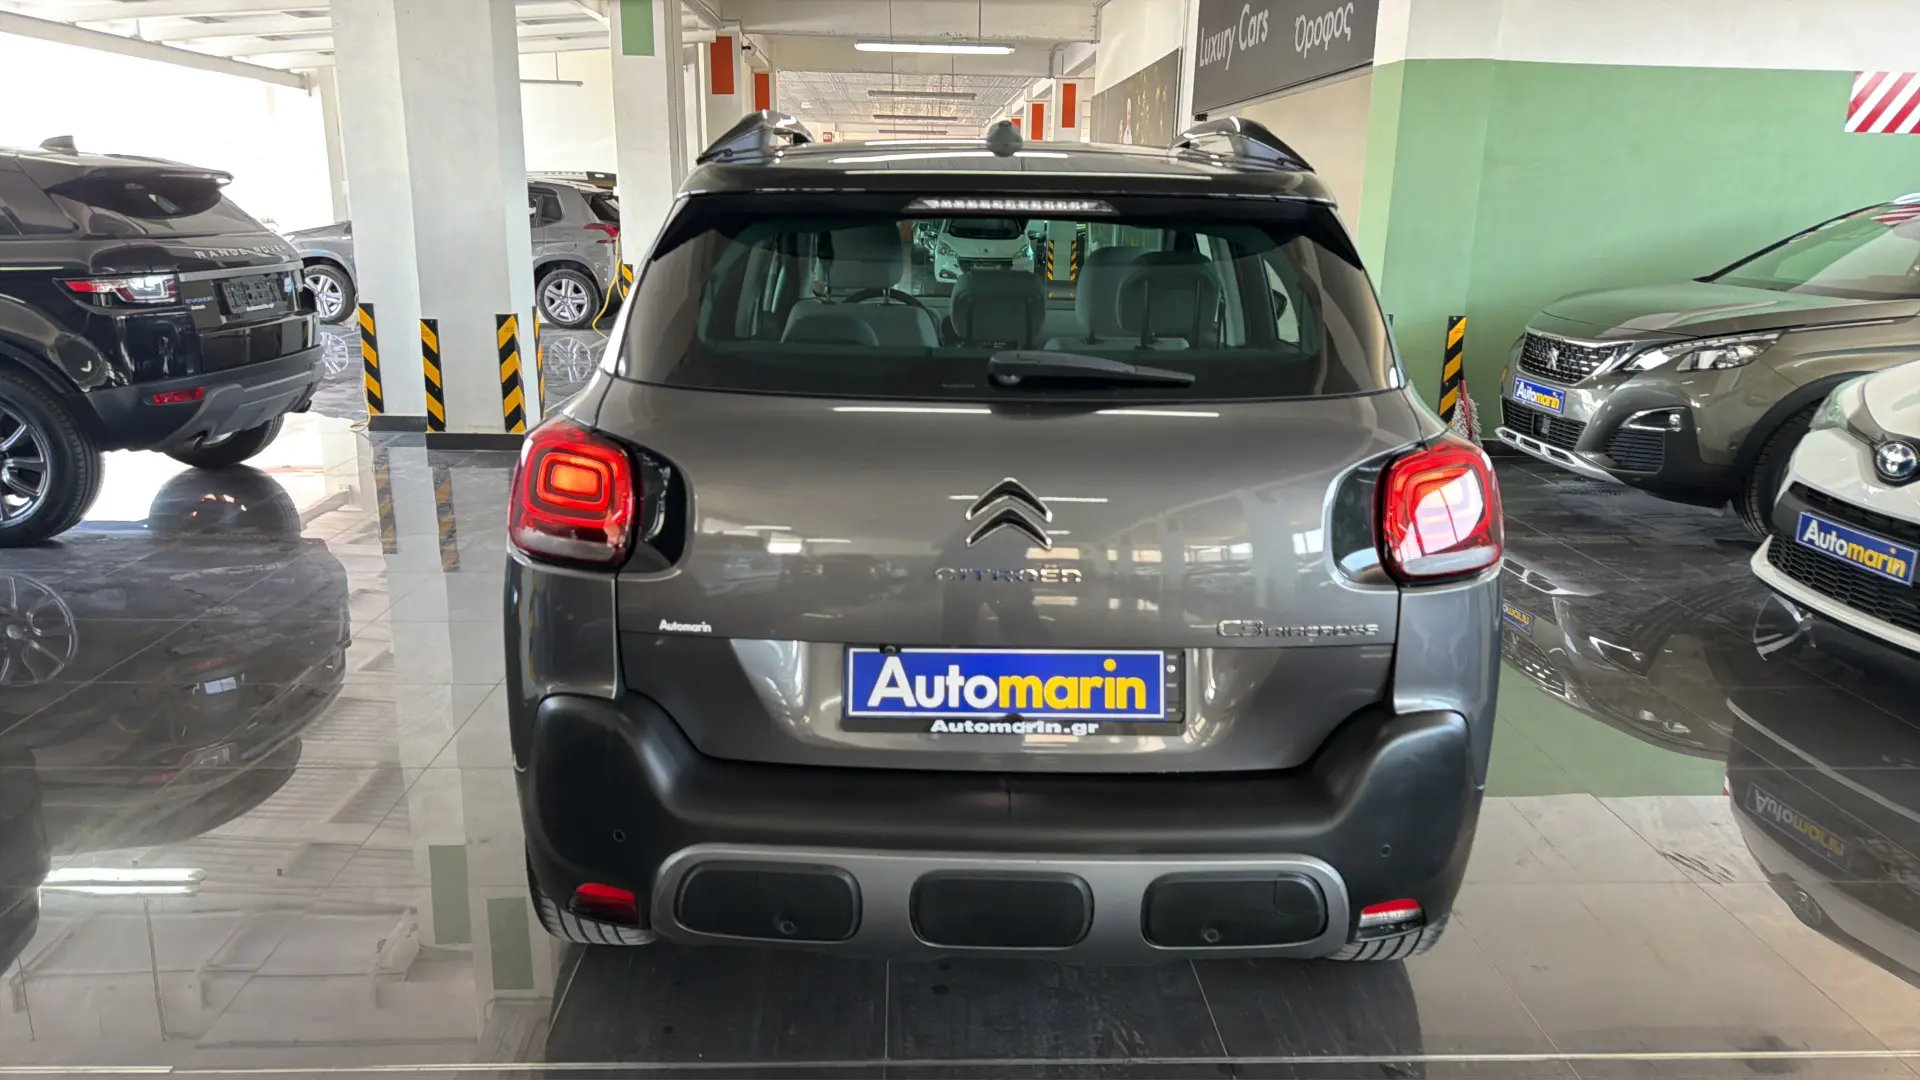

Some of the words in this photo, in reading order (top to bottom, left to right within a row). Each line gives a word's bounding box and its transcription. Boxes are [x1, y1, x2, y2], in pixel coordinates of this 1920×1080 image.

[1199, 25, 1236, 70] Luxury
[1239, 3, 1269, 51] Cars
[193, 247, 247, 259] RANGE
[1516, 381, 1560, 410] Automarin
[1803, 519, 1907, 578] Automarin
[658, 619, 713, 633] Automarin
[1216, 619, 1264, 638] C3
[867, 655, 1147, 709] Automarin
[930, 719, 1100, 735] Automarin.gr
